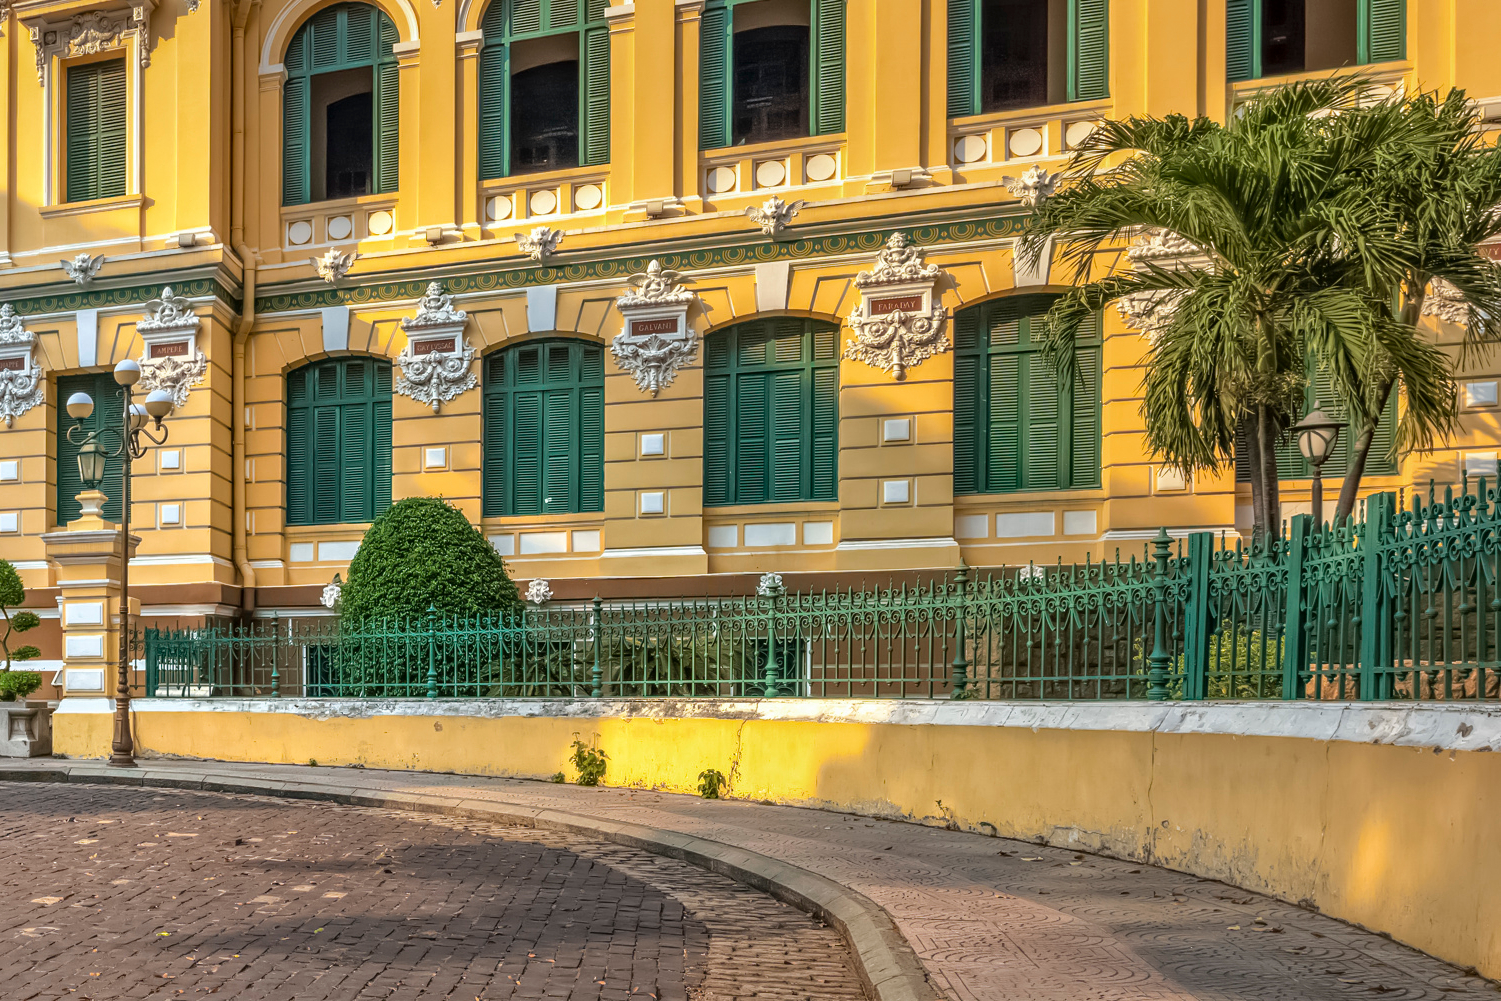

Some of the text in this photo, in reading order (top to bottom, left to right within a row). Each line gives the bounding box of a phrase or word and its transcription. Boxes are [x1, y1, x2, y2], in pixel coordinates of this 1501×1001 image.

[878, 300, 916, 311] FARADAY
[638, 322, 672, 332] GALVANI
[156, 345, 183, 354] AMPERE
[417, 343, 430, 352] GAY
